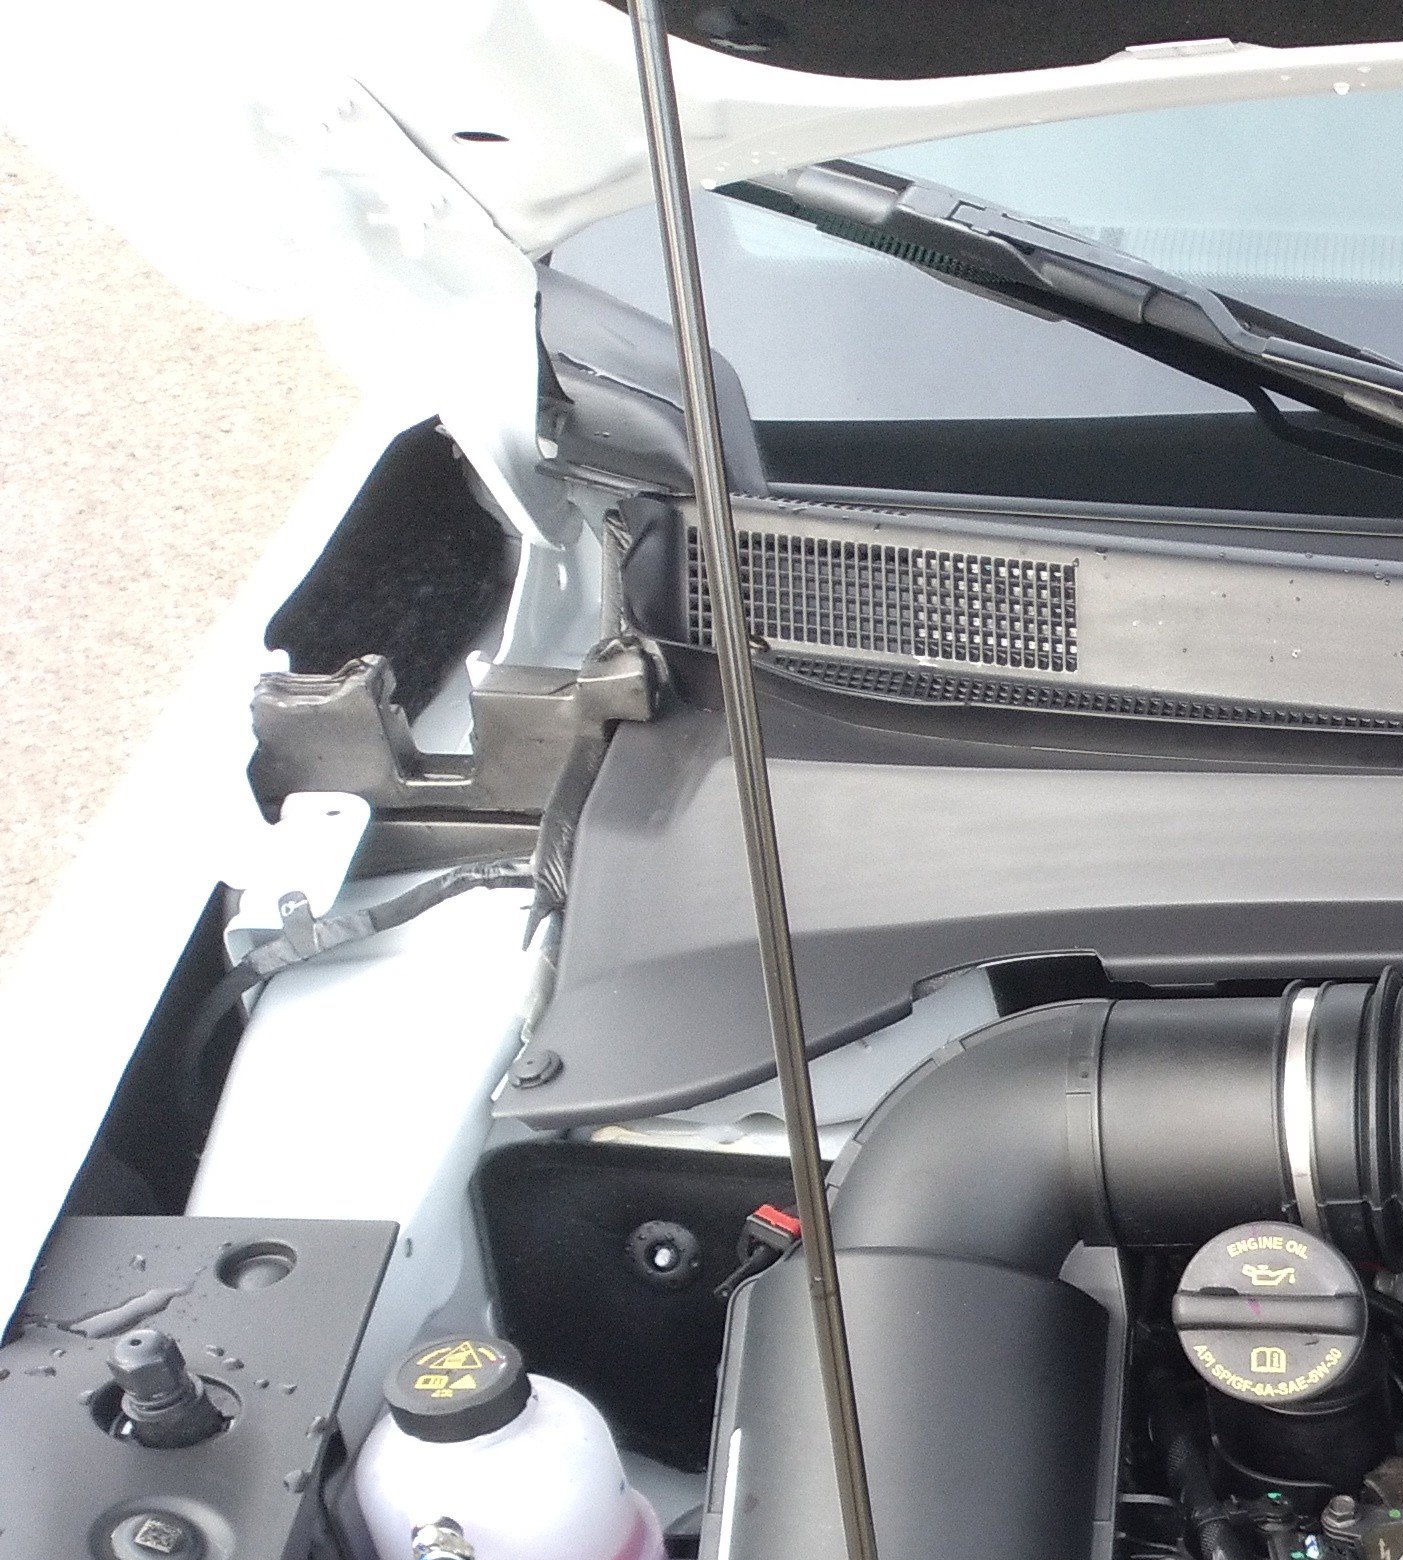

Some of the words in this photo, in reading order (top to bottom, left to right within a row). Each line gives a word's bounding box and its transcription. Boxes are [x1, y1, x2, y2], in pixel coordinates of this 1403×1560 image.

[1226, 1236, 1284, 1259] ENGINE
[1285, 1238, 1308, 1260] OIL
[1193, 1343, 1217, 1369] API
